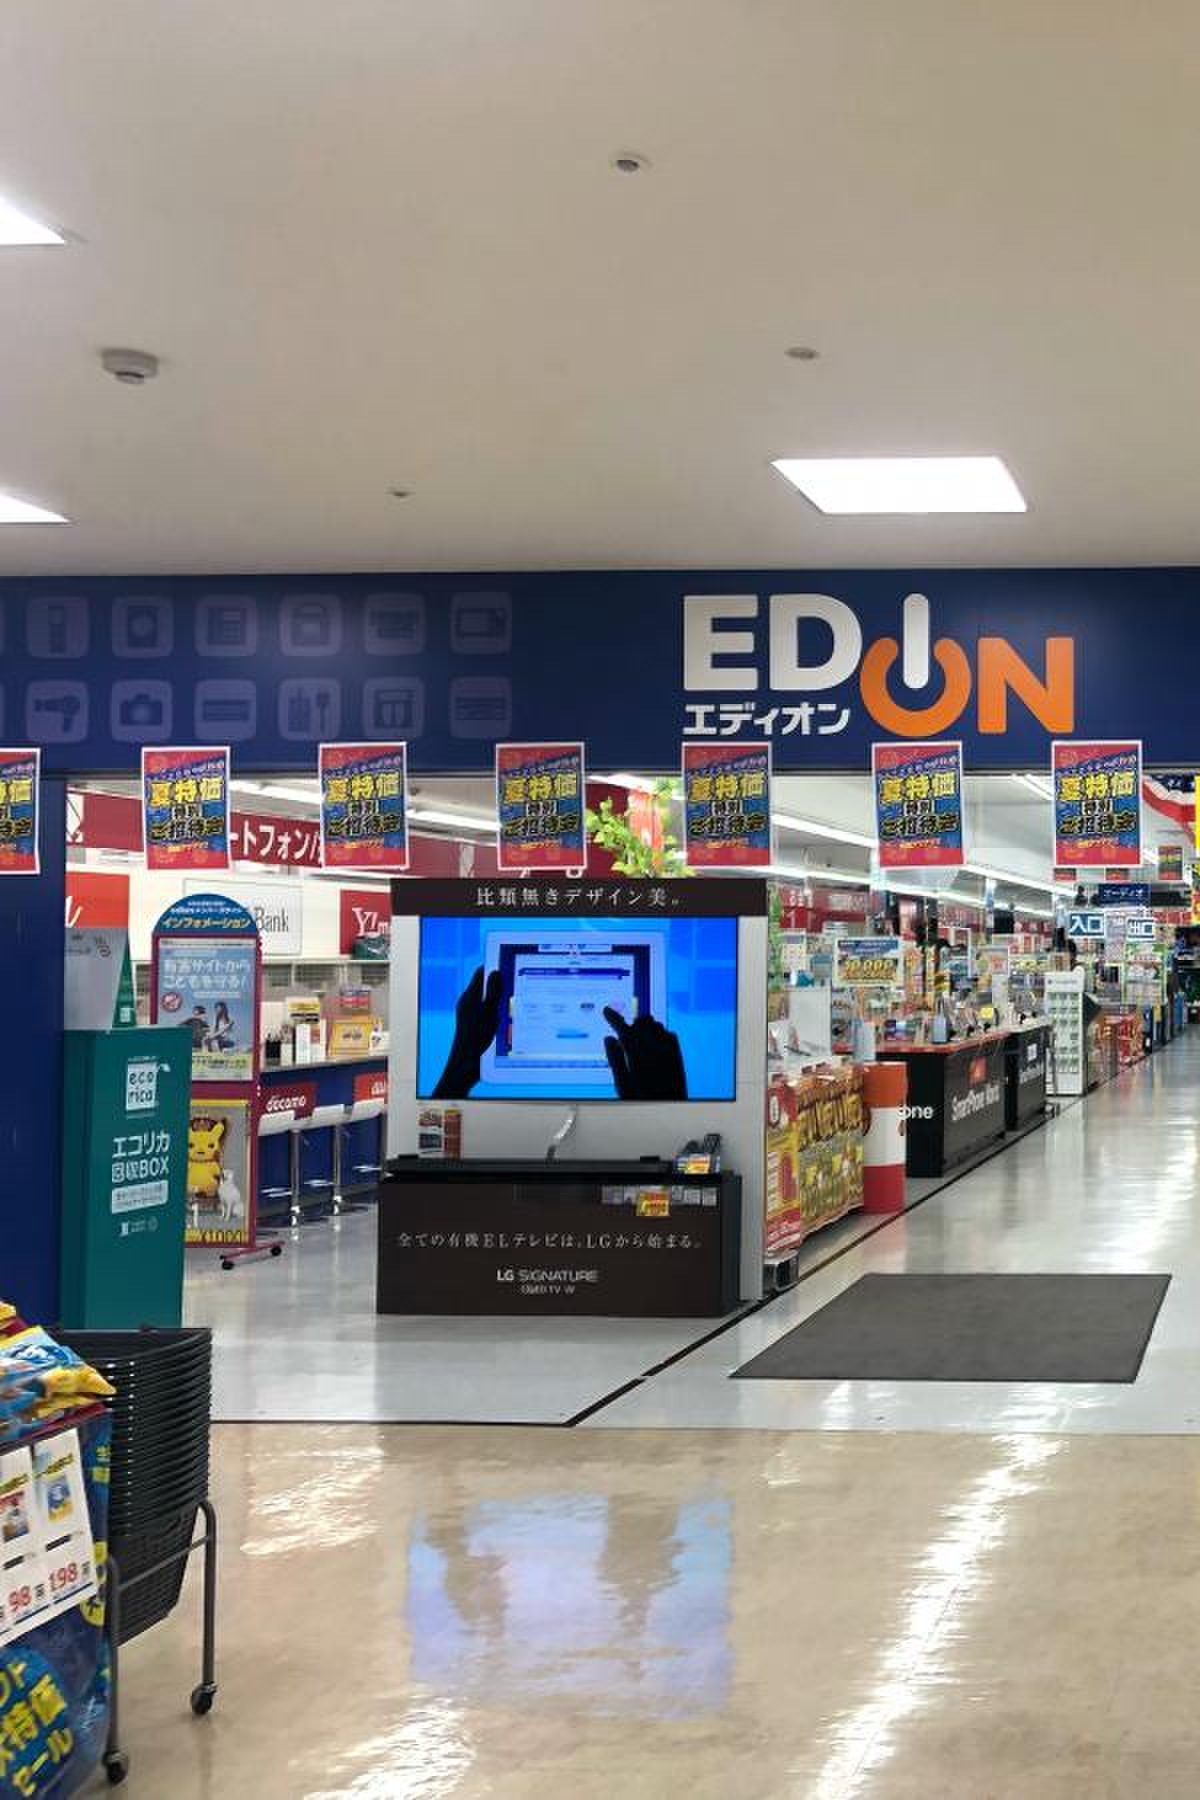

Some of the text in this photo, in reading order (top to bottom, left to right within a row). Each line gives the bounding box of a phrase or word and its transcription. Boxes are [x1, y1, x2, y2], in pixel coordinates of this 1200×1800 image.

[683, 593, 1075, 737] EDION
[682, 702, 850, 736] エディオン
[476, 887, 681, 907] 比類無きデザイン美。
[1069, 914, 1104, 934] 入口
[112, 1130, 170, 1159] エコリカ
[112, 1156, 170, 1184] 回収BOX
[496, 1269, 599, 1282] LG SIGNATURE
